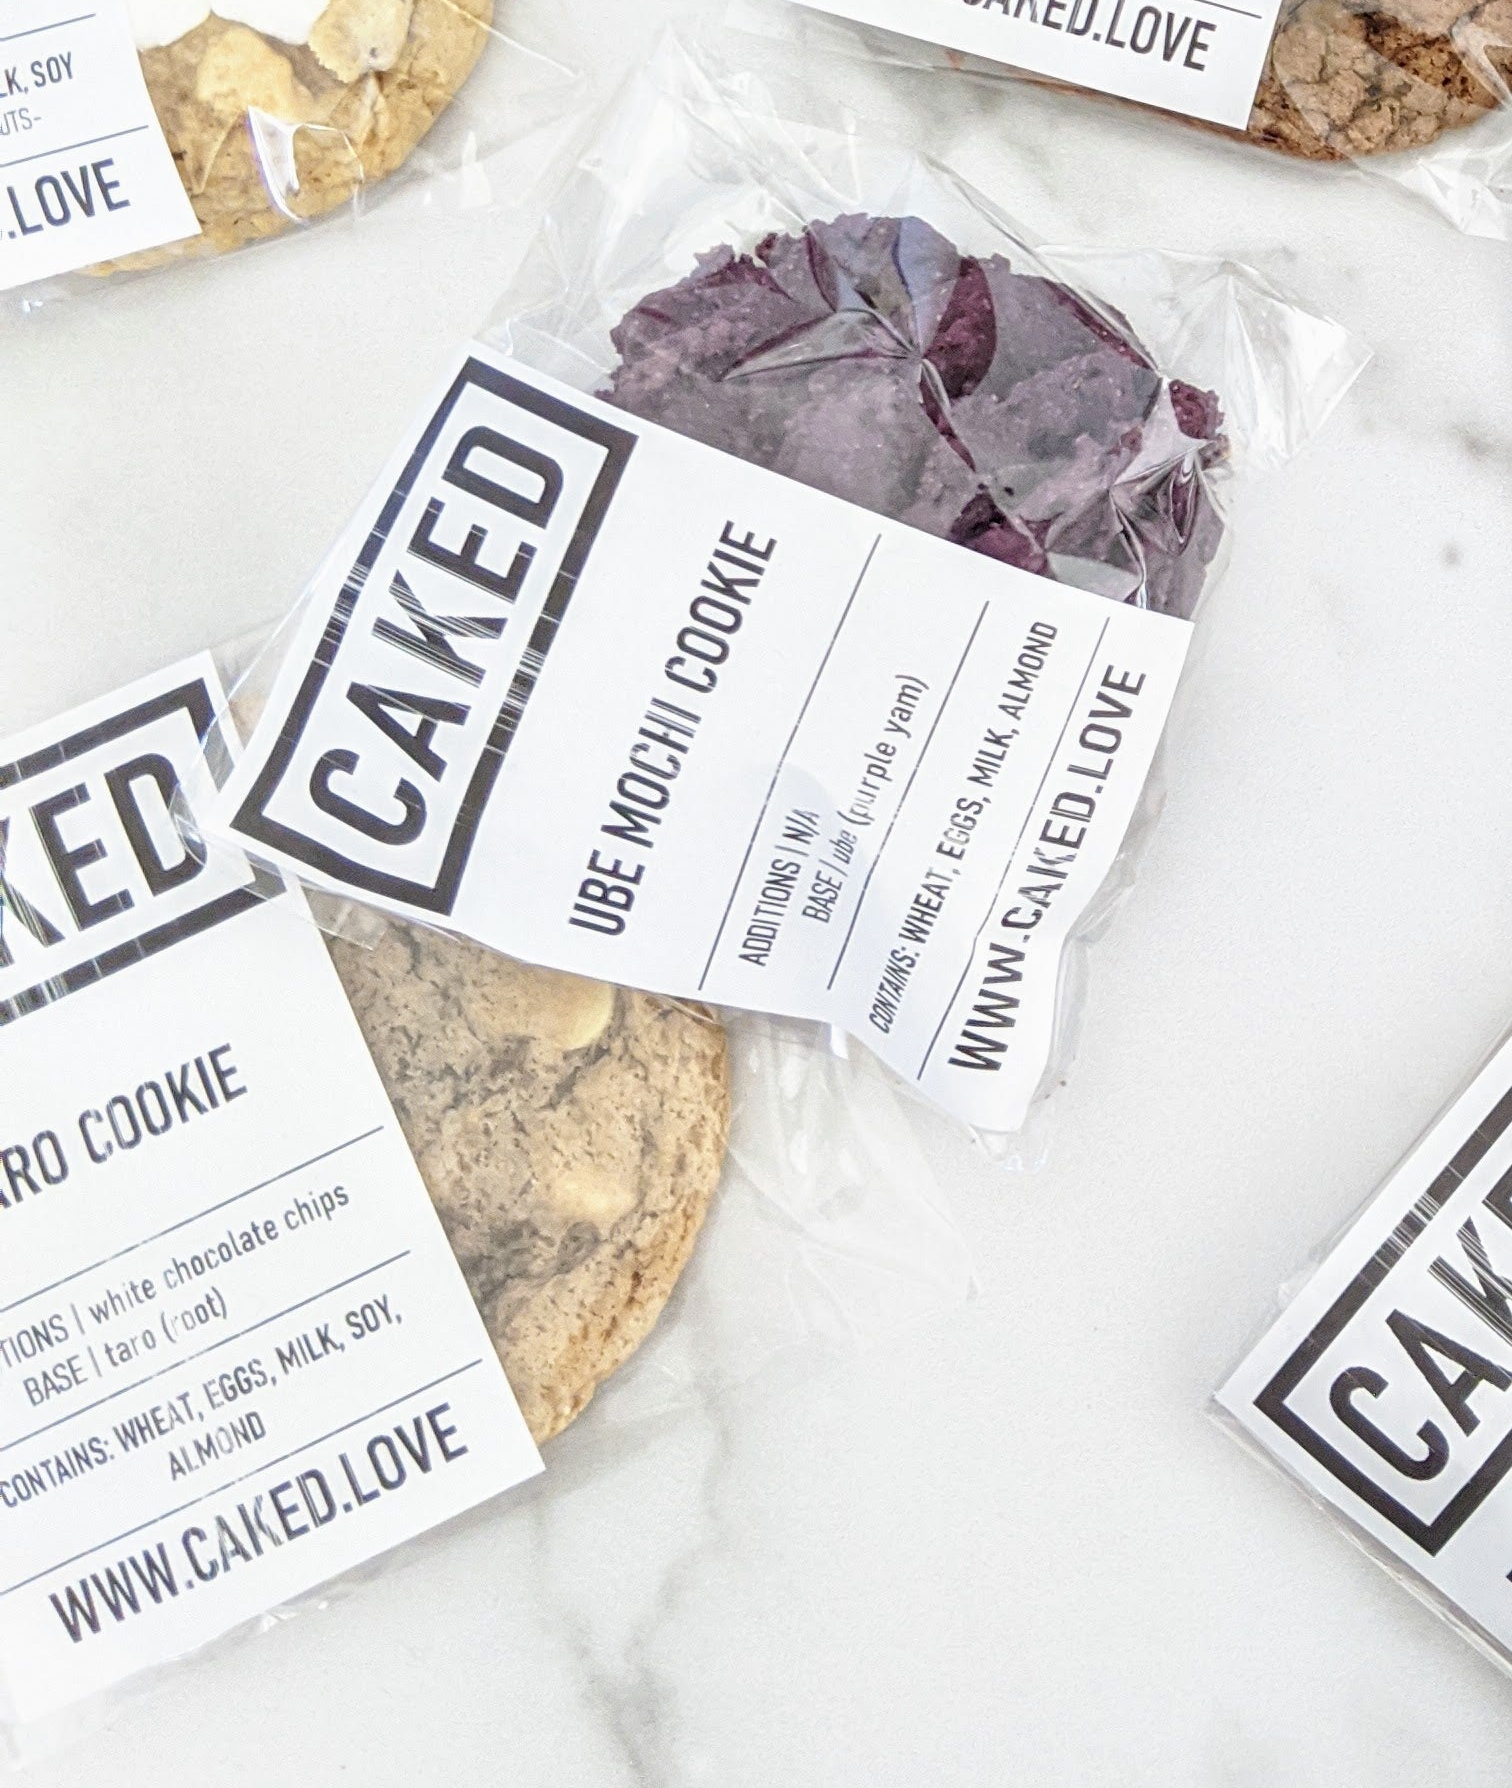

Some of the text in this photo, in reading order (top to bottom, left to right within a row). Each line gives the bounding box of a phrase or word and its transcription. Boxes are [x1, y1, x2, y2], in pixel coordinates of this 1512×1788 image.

[30, 51, 73, 87] SOY
[309, 426, 564, 845] CAKED
[568, 520, 777, 936] UBE MOCHI COOKIE
[738, 809, 820, 966] ADDITIONS N/A
[801, 674, 929, 923] BASE ube yam)
[868, 621, 1057, 1034] CONTAINS: WHEAT, EGGS, MILK, ALMOND
[947, 664, 1146, 1071] WWW.CAKED.LOVE
[78, 1042, 248, 1164] COOKIE
[88, 1185, 349, 1324] white chocolate chips
[0, 1294, 402, 1508] CONTAINS: WHEAT, EGGS, MILK, SOY,
[22, 1354, 88, 1406] BASE
[104, 1329, 156, 1367] taro
[168, 1411, 266, 1481] ALMOND
[48, 1402, 469, 1643] WWW.CAKED.LOVE
